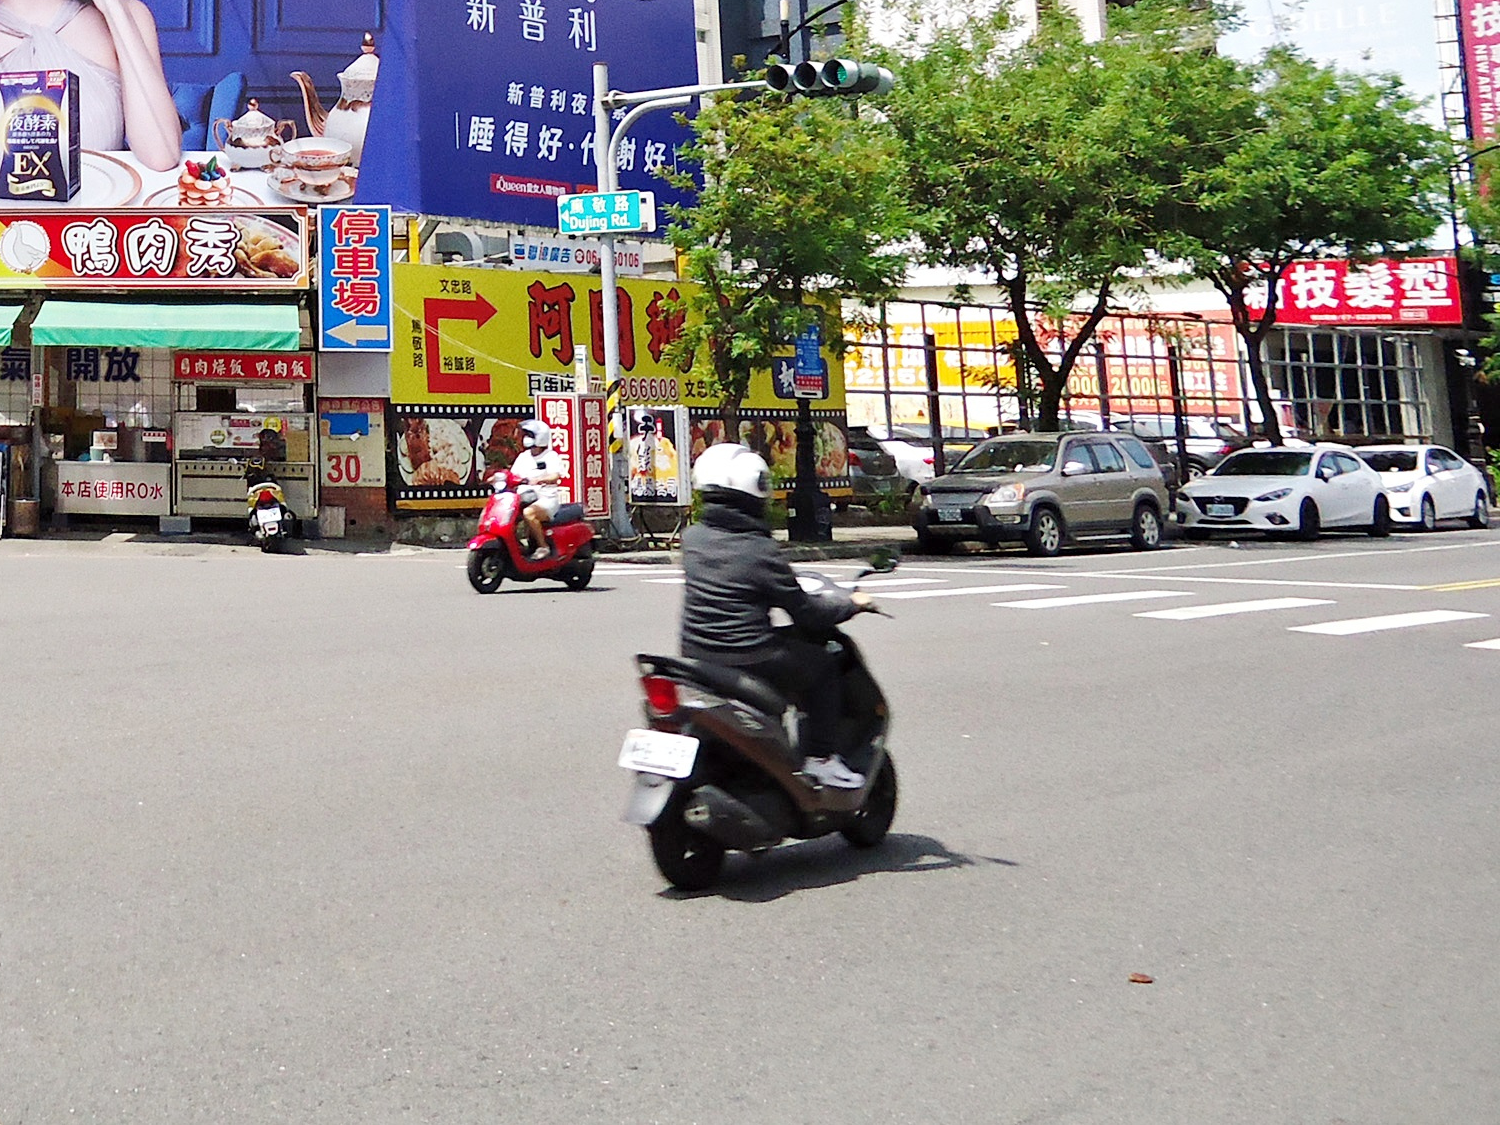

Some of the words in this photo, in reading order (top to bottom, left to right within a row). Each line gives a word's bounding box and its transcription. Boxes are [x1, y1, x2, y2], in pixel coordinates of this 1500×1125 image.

[1473, 44, 1489, 73] NEW
[1477, 75, 1492, 101] ART
[9, 114, 57, 132] 夜酵素
[12, 151, 52, 176] EX
[570, 213, 608, 230] Dujing
[611, 213, 630, 227] Rd.
[65, 216, 242, 276] 鴨肉秀
[331, 209, 381, 317] 停車場
[440, 279, 472, 294] 文忠路
[67, 346, 142, 383] 開放
[255, 359, 308, 378] 鴨肉飯
[327, 455, 361, 483] 30
[62, 480, 163, 500] 本店使用RO水
